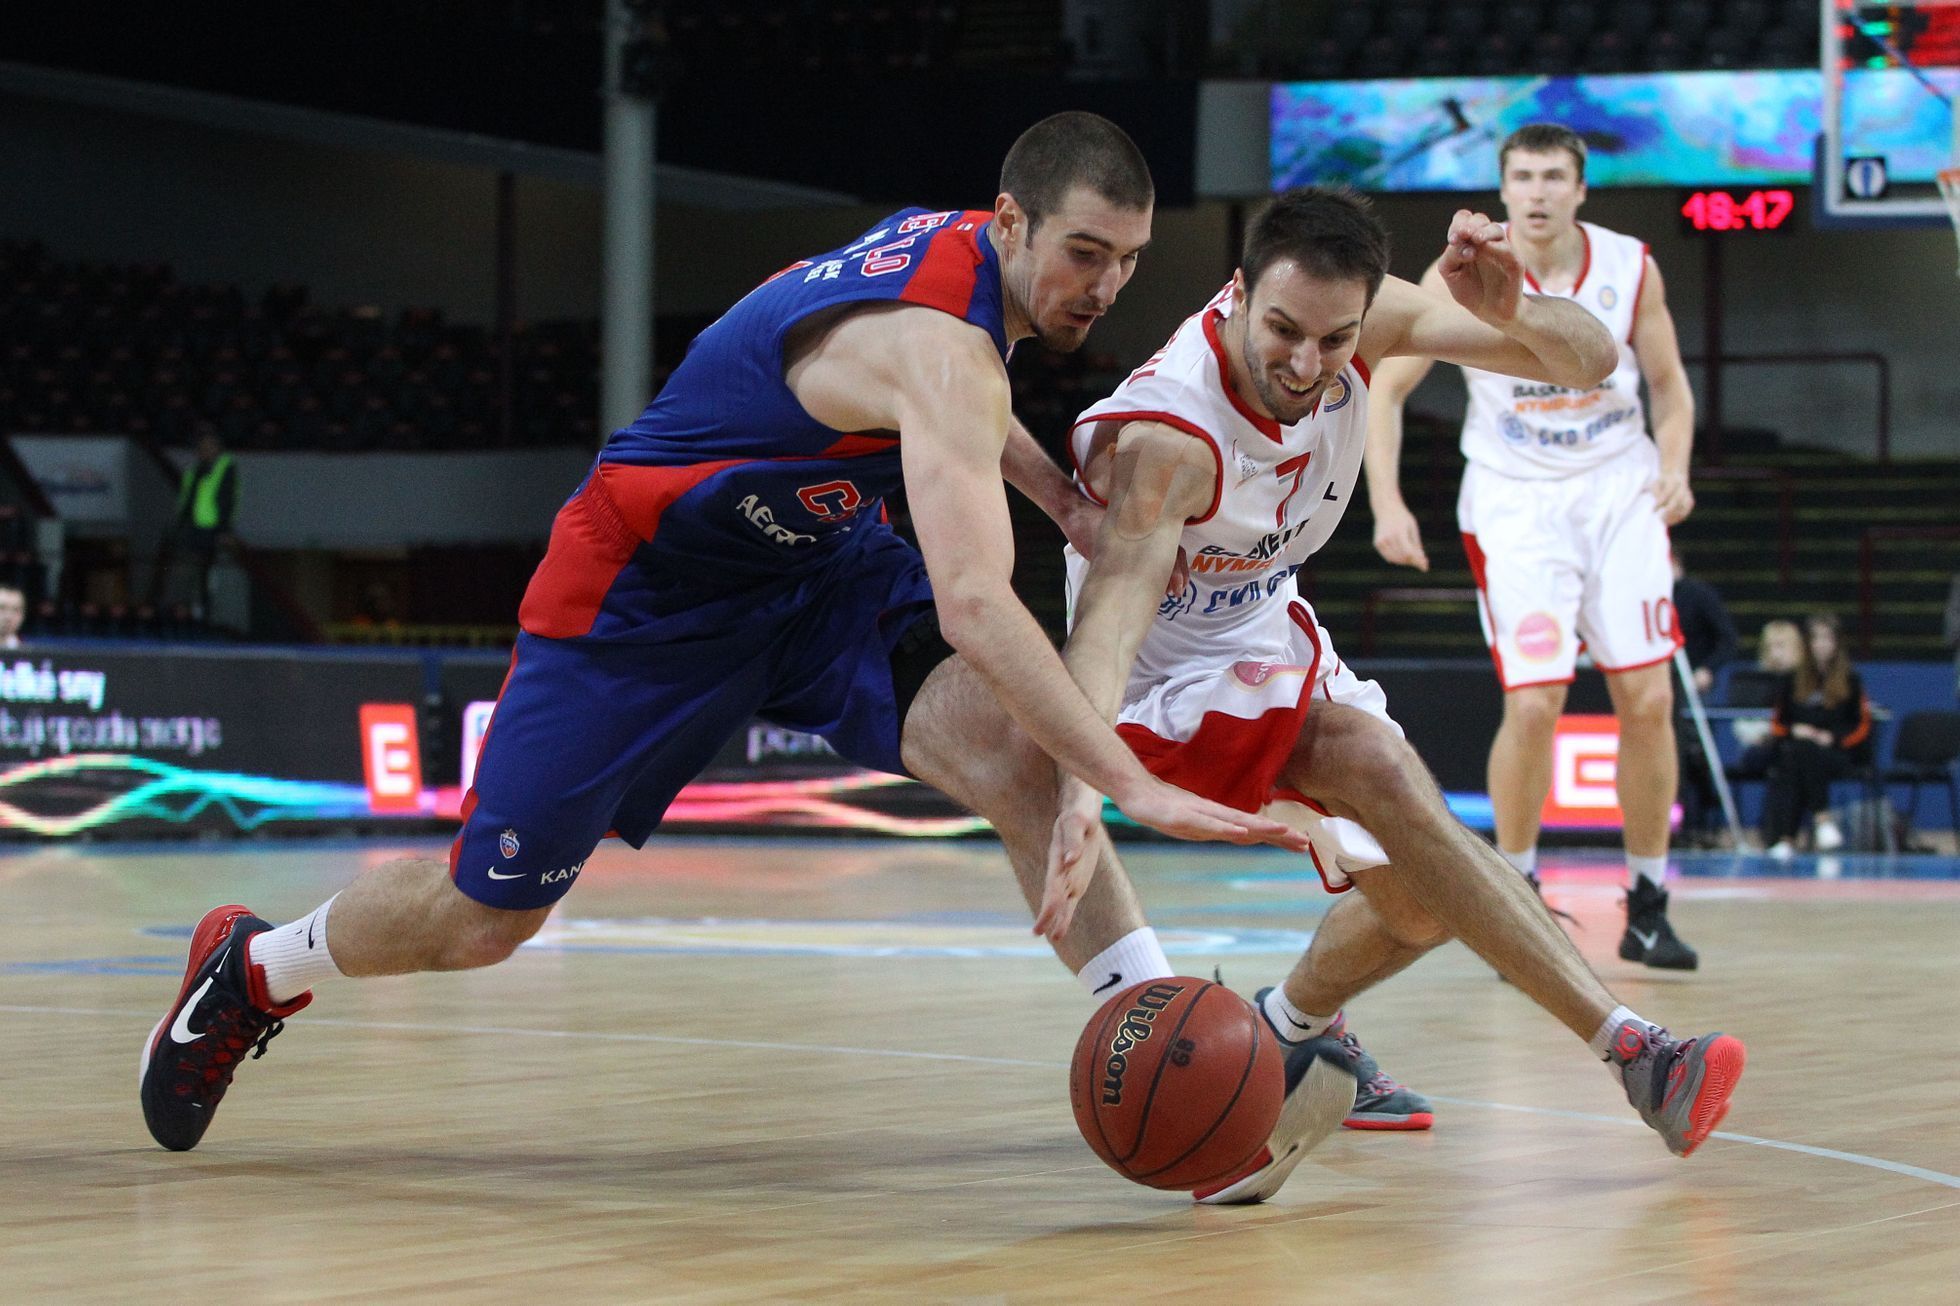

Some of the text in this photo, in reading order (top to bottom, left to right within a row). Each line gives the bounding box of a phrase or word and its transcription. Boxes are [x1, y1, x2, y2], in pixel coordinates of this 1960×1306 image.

[1682, 191, 1794, 230] 18:17
[1275, 451, 1312, 528] 7
[1102, 984, 1186, 1107] Wilson
